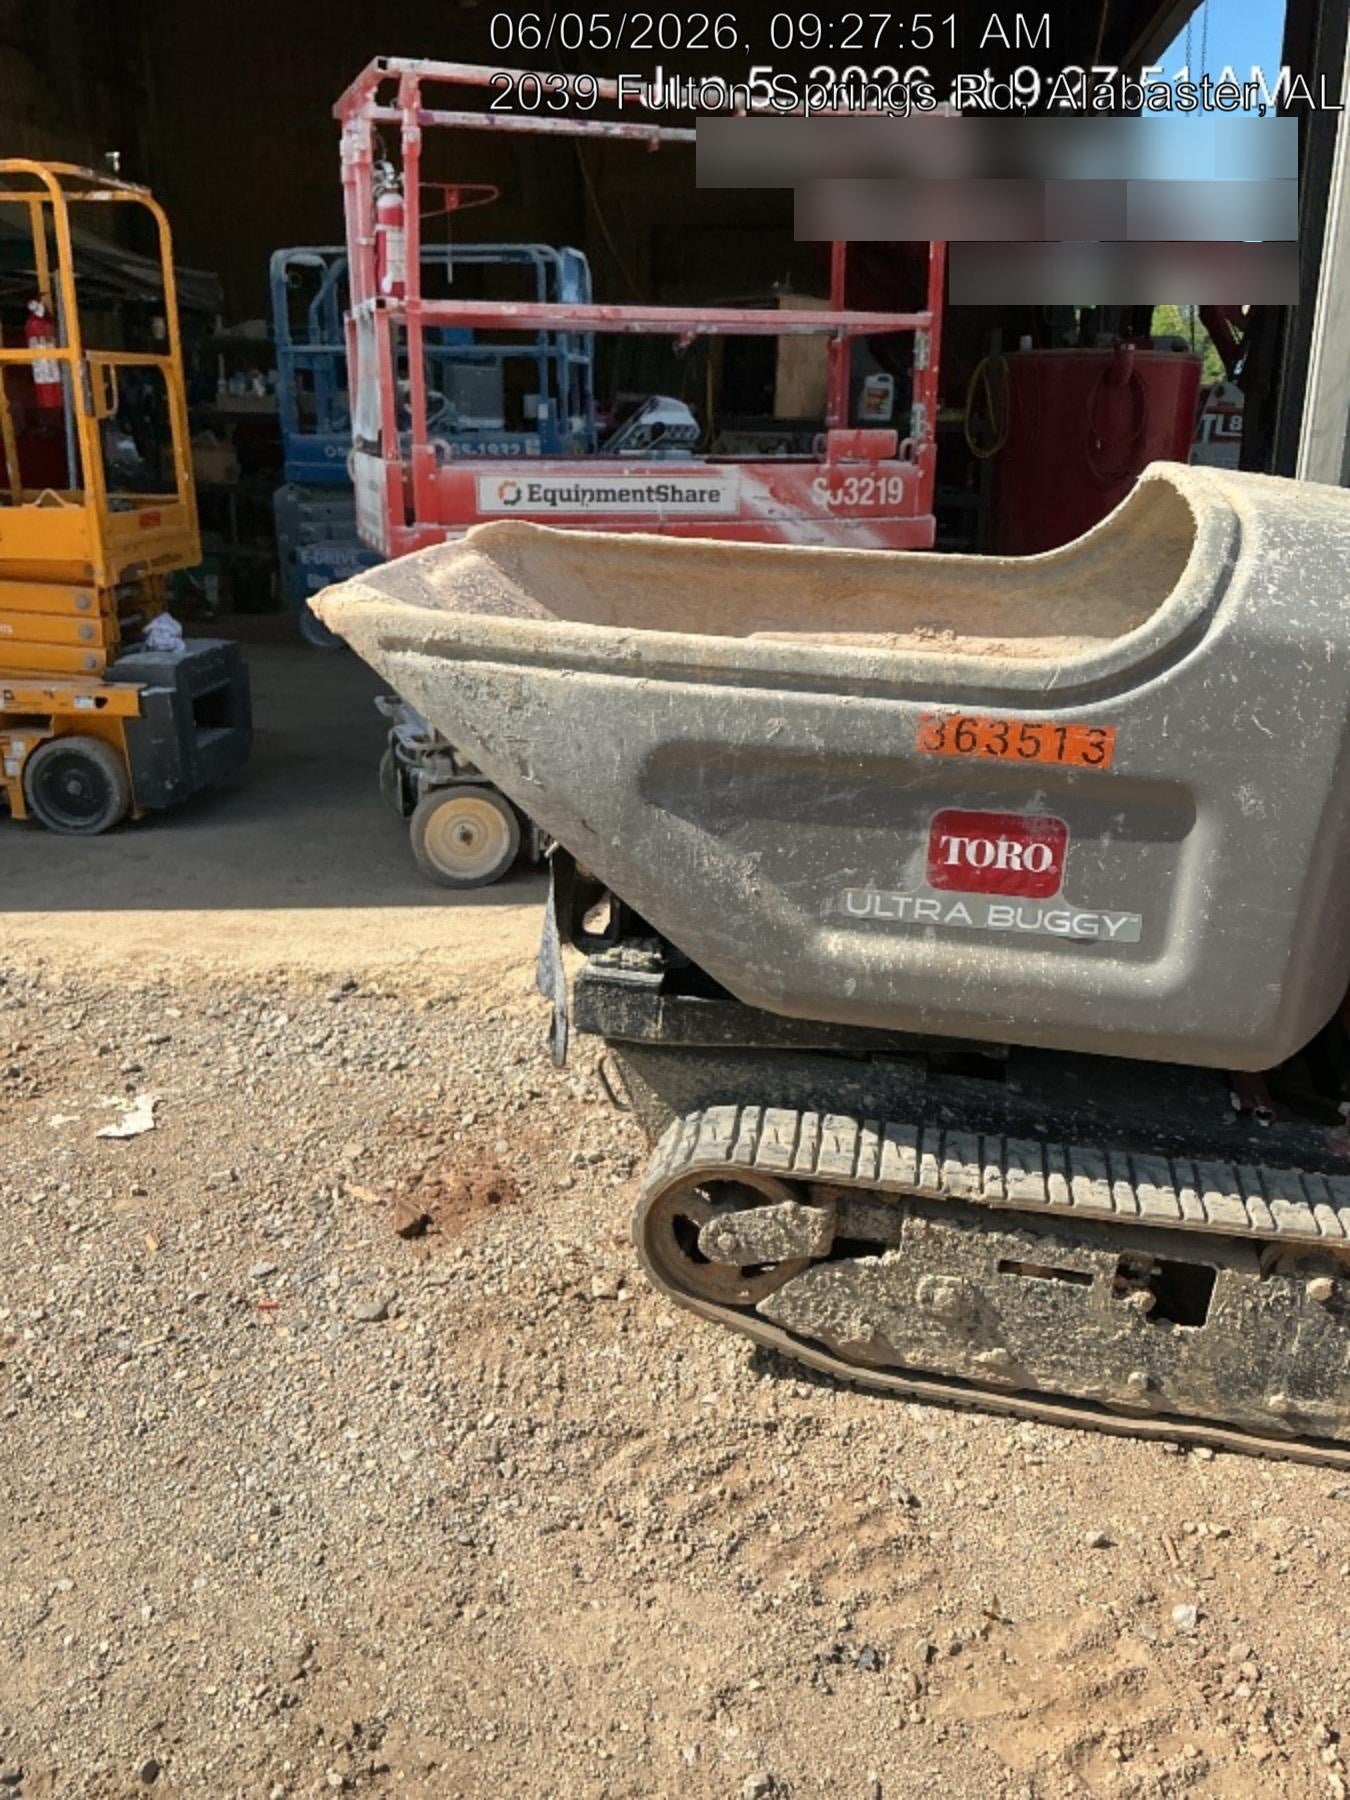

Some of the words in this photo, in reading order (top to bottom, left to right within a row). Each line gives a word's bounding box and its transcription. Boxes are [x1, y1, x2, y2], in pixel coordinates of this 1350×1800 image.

[527, 483, 721, 506] EquipmentShare
[922, 716, 1107, 765] 363513
[940, 835, 1053, 873] TORO
[846, 893, 973, 924] ULTRA
[987, 904, 1127, 936] BUGGY
